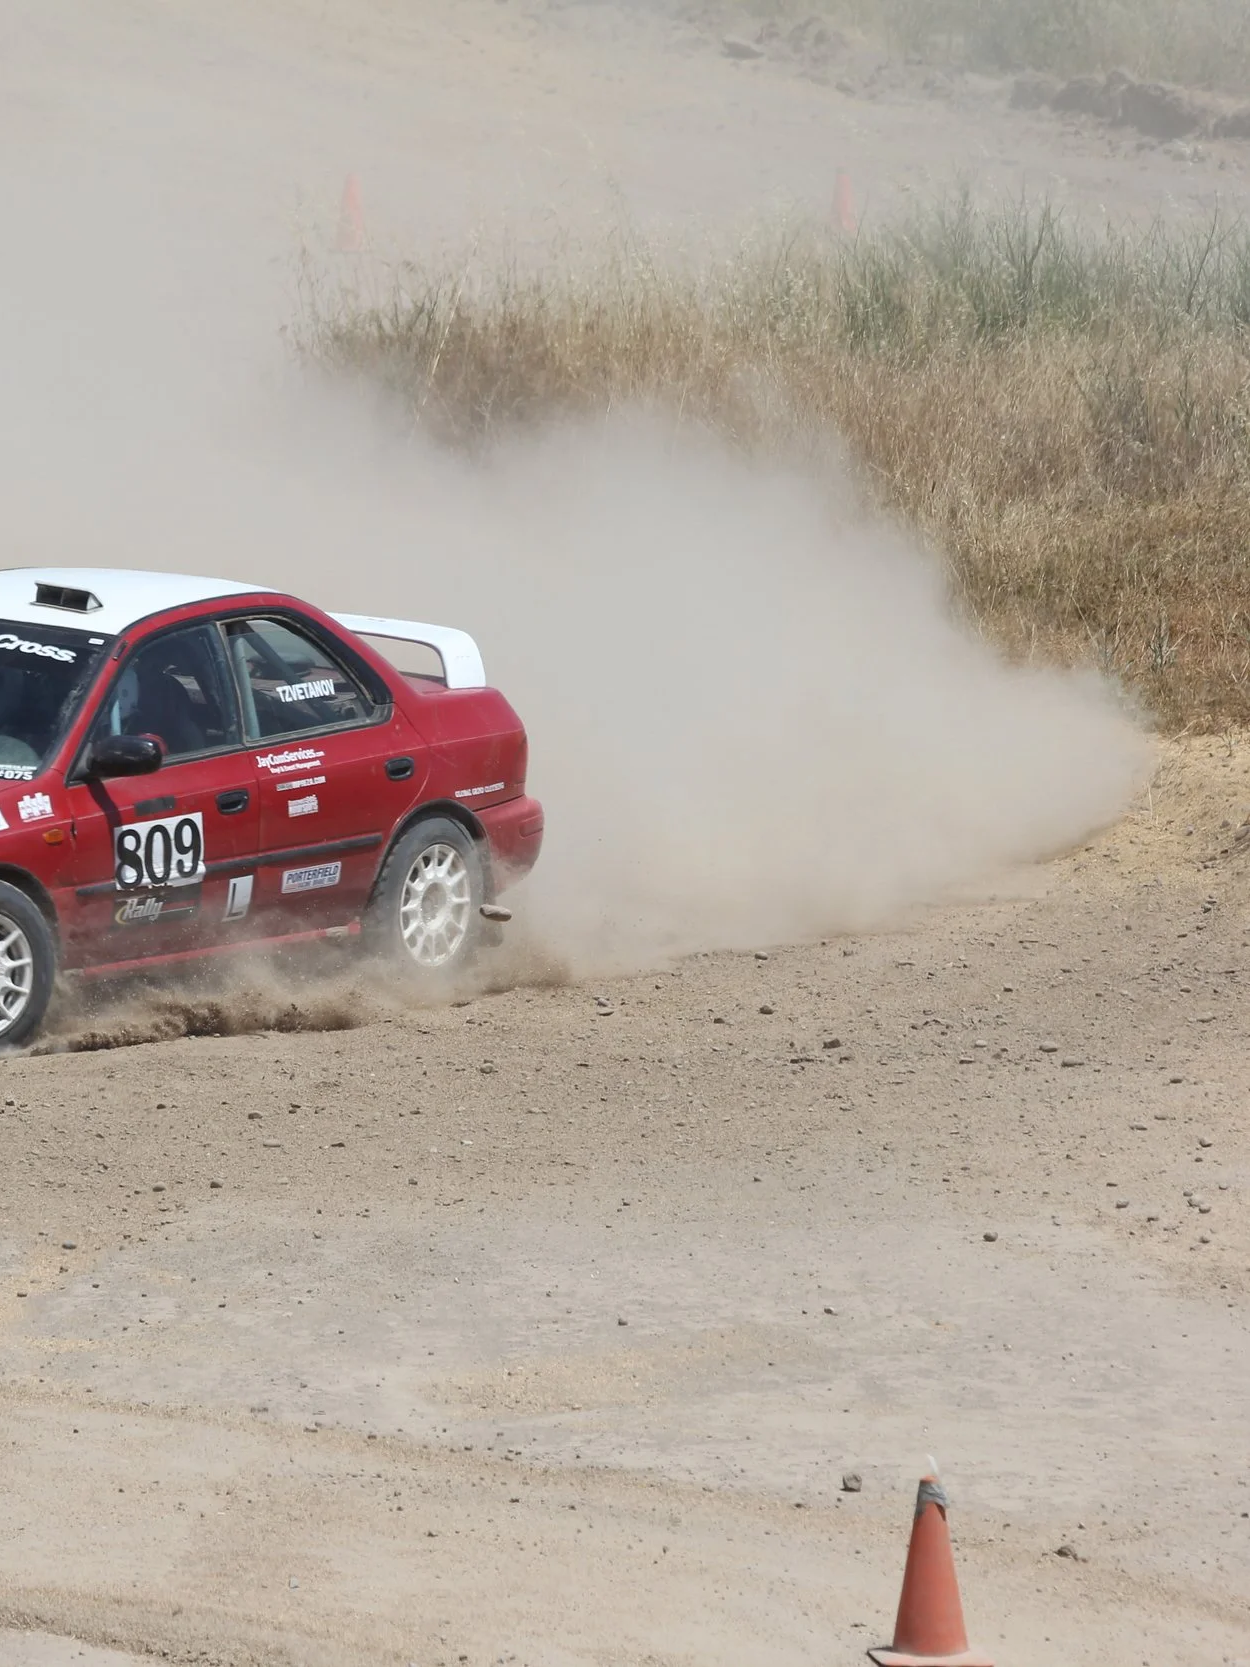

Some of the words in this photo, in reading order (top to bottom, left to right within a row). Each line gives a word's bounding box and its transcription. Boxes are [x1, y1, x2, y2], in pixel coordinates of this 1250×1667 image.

[276, 679, 335, 703] TZVETANOV
[115, 818, 201, 890] 809
[286, 865, 339, 884] PORTERFIELD
[122, 897, 164, 921] Rally
